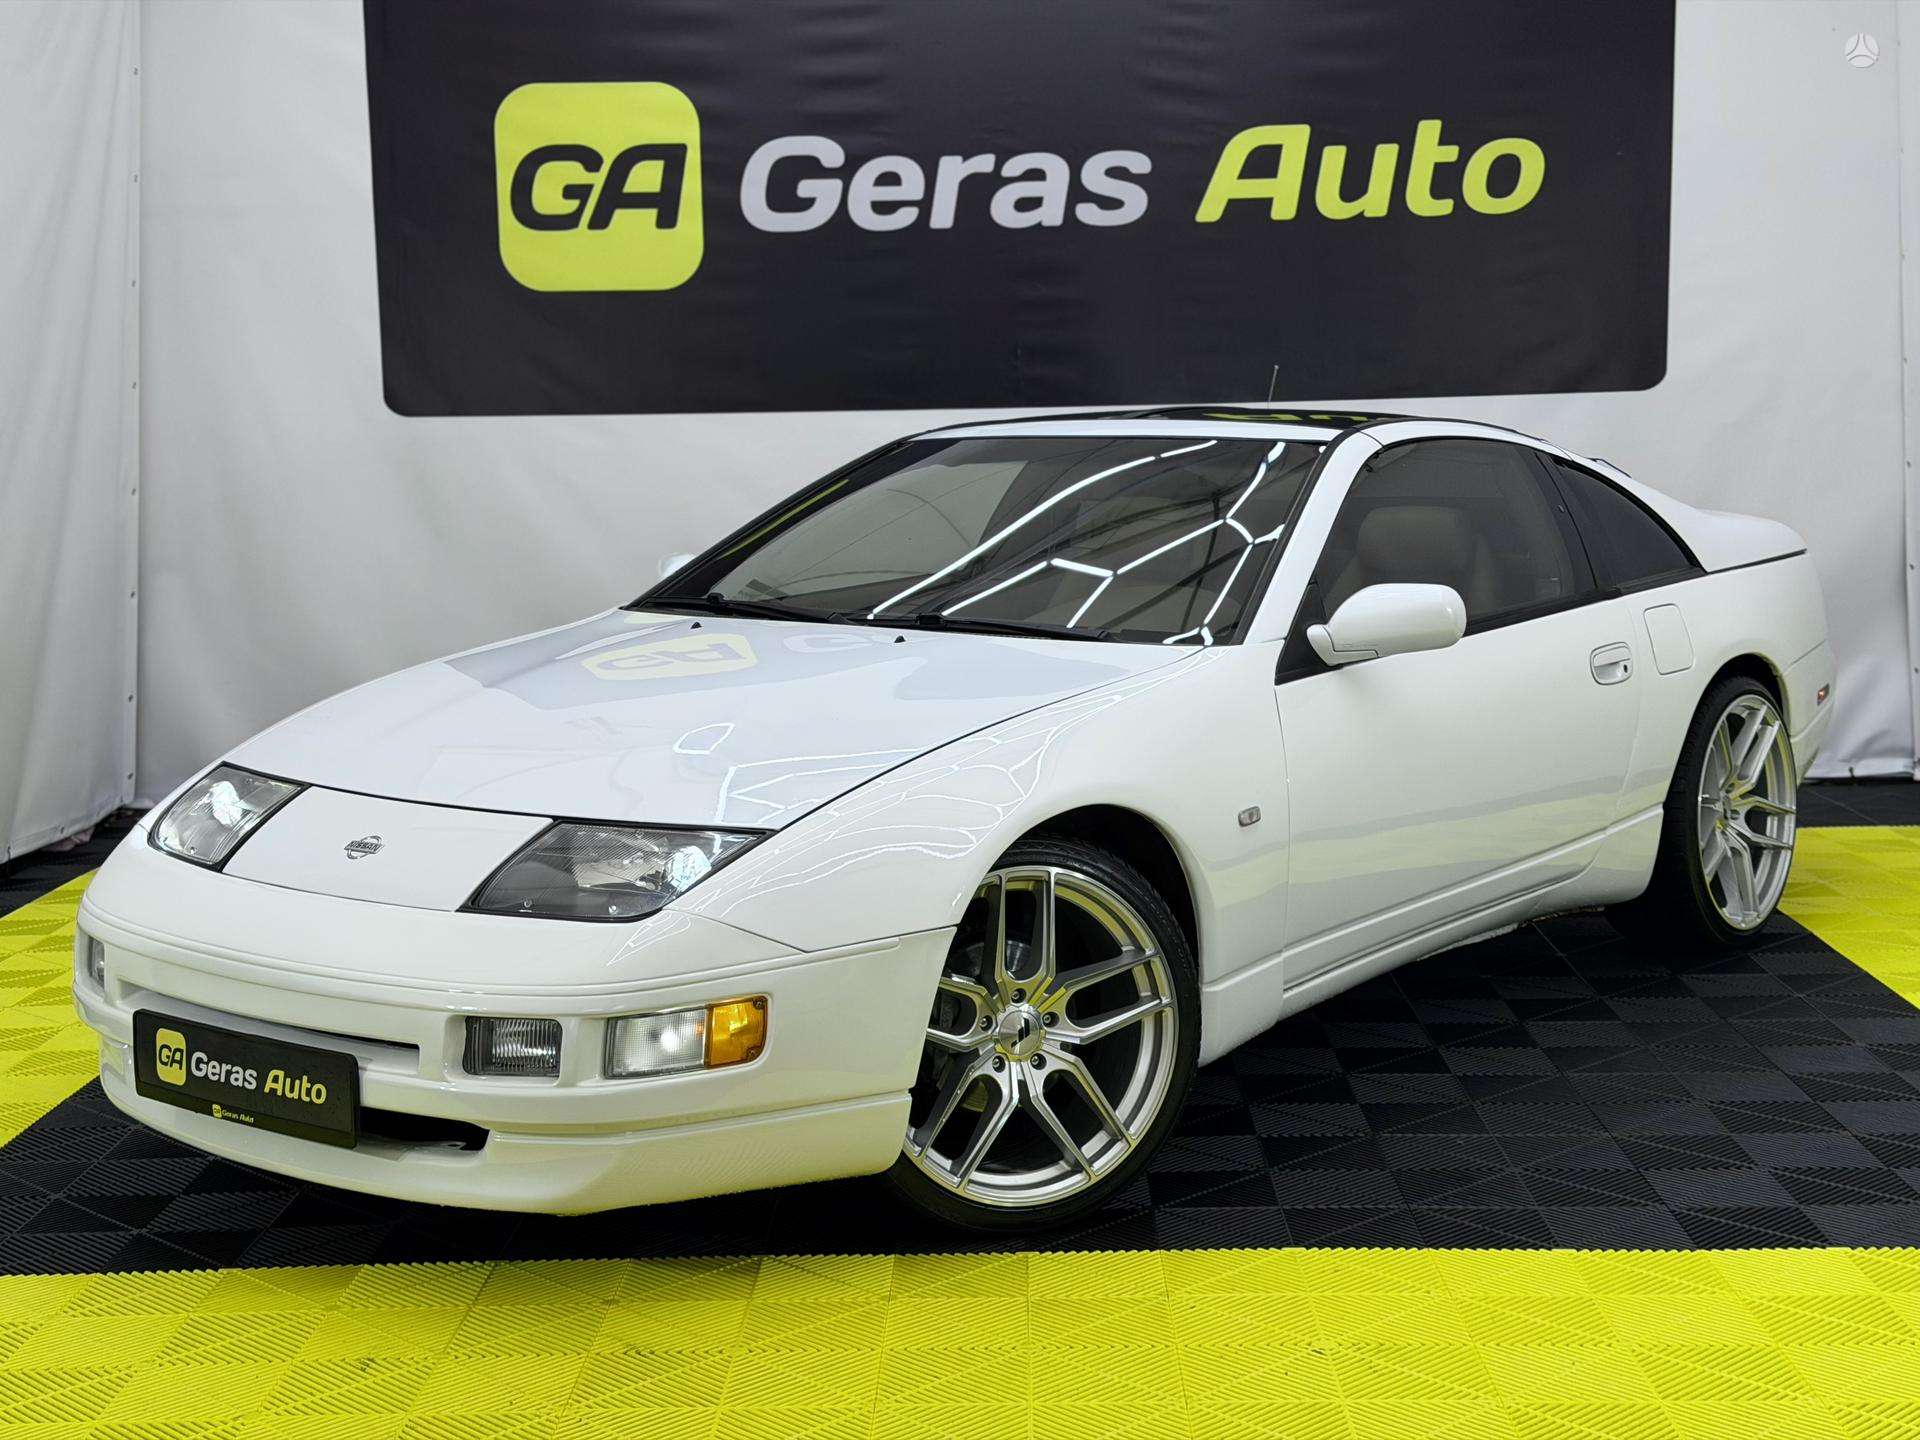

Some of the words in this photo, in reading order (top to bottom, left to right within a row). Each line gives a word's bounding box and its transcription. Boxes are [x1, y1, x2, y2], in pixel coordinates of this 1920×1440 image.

[511, 143, 687, 231] GA
[741, 136, 1151, 232] Geras
[1195, 120, 1545, 222] Auto
[158, 1044, 184, 1070] GA
[190, 1052, 257, 1089] Geras
[263, 1069, 326, 1104] Auto
